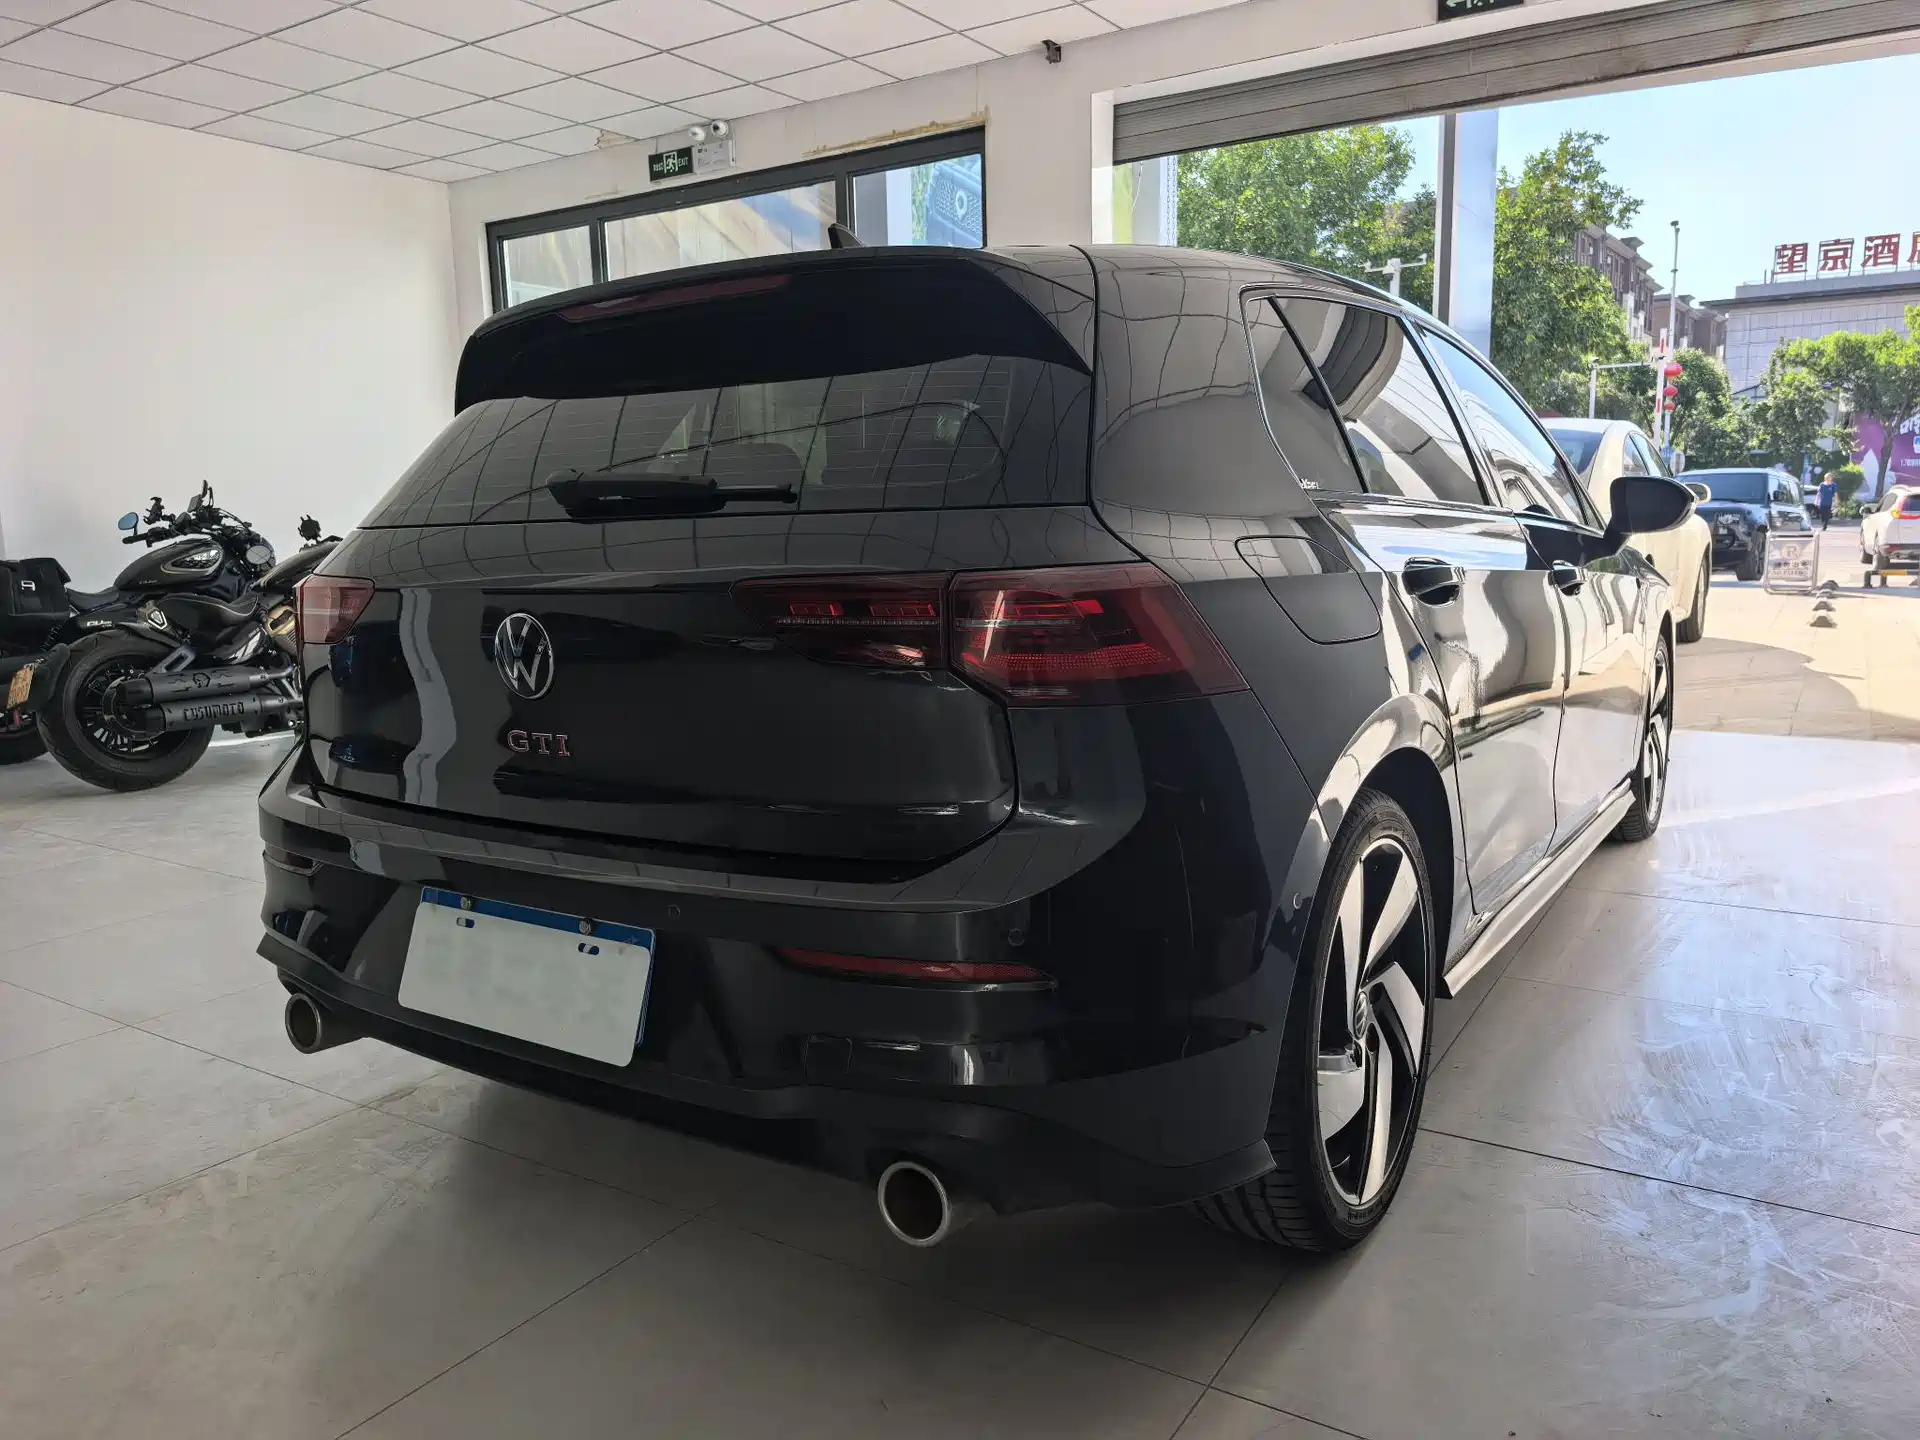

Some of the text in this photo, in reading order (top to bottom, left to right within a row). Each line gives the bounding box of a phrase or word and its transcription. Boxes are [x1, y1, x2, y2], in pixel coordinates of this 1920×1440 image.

[678, 157, 688, 166] EXIT
[496, 614, 551, 697] VW
[507, 729, 571, 757] GTI
